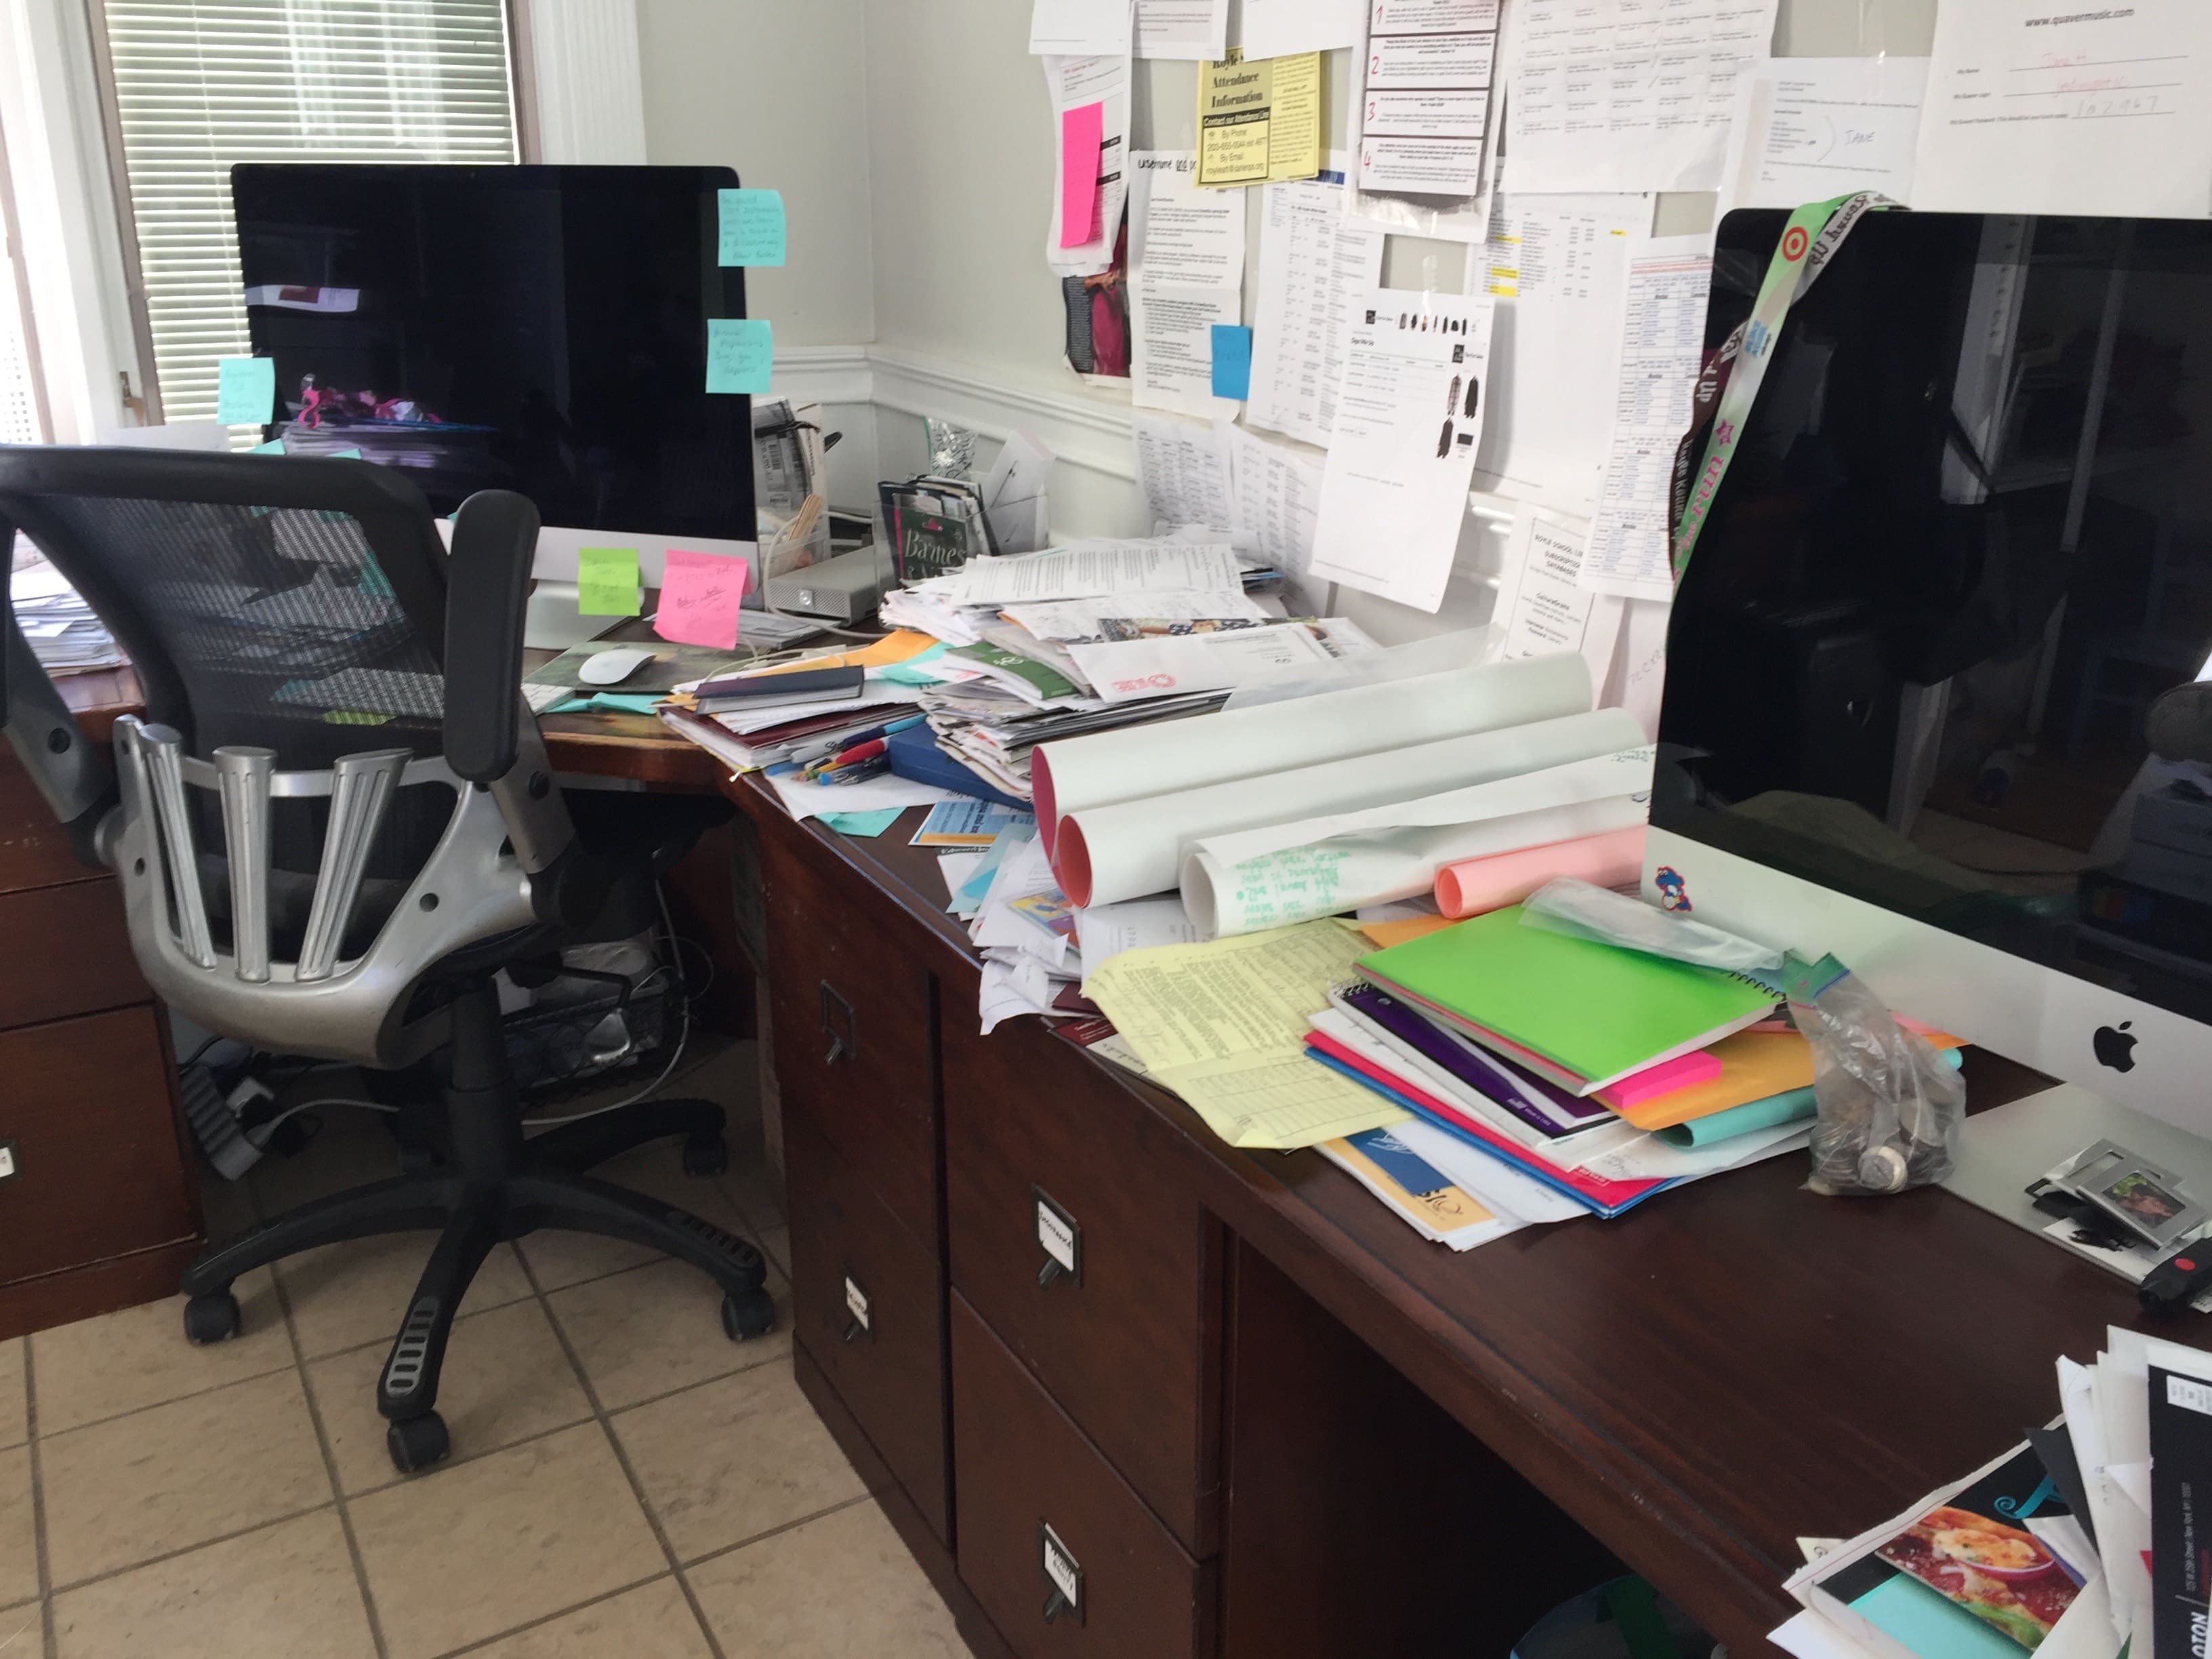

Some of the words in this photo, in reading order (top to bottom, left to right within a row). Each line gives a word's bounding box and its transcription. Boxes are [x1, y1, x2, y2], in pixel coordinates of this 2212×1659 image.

[1376, 5, 1383, 24] 1
[2024, 8, 2135, 27] www.quavermusic.com
[1371, 56, 1380, 75] 2
[1211, 71, 1259, 88] Attendance
[1210, 90, 1263, 108] Information
[1367, 102, 1376, 121] 3
[905, 529, 966, 566] Barnes
